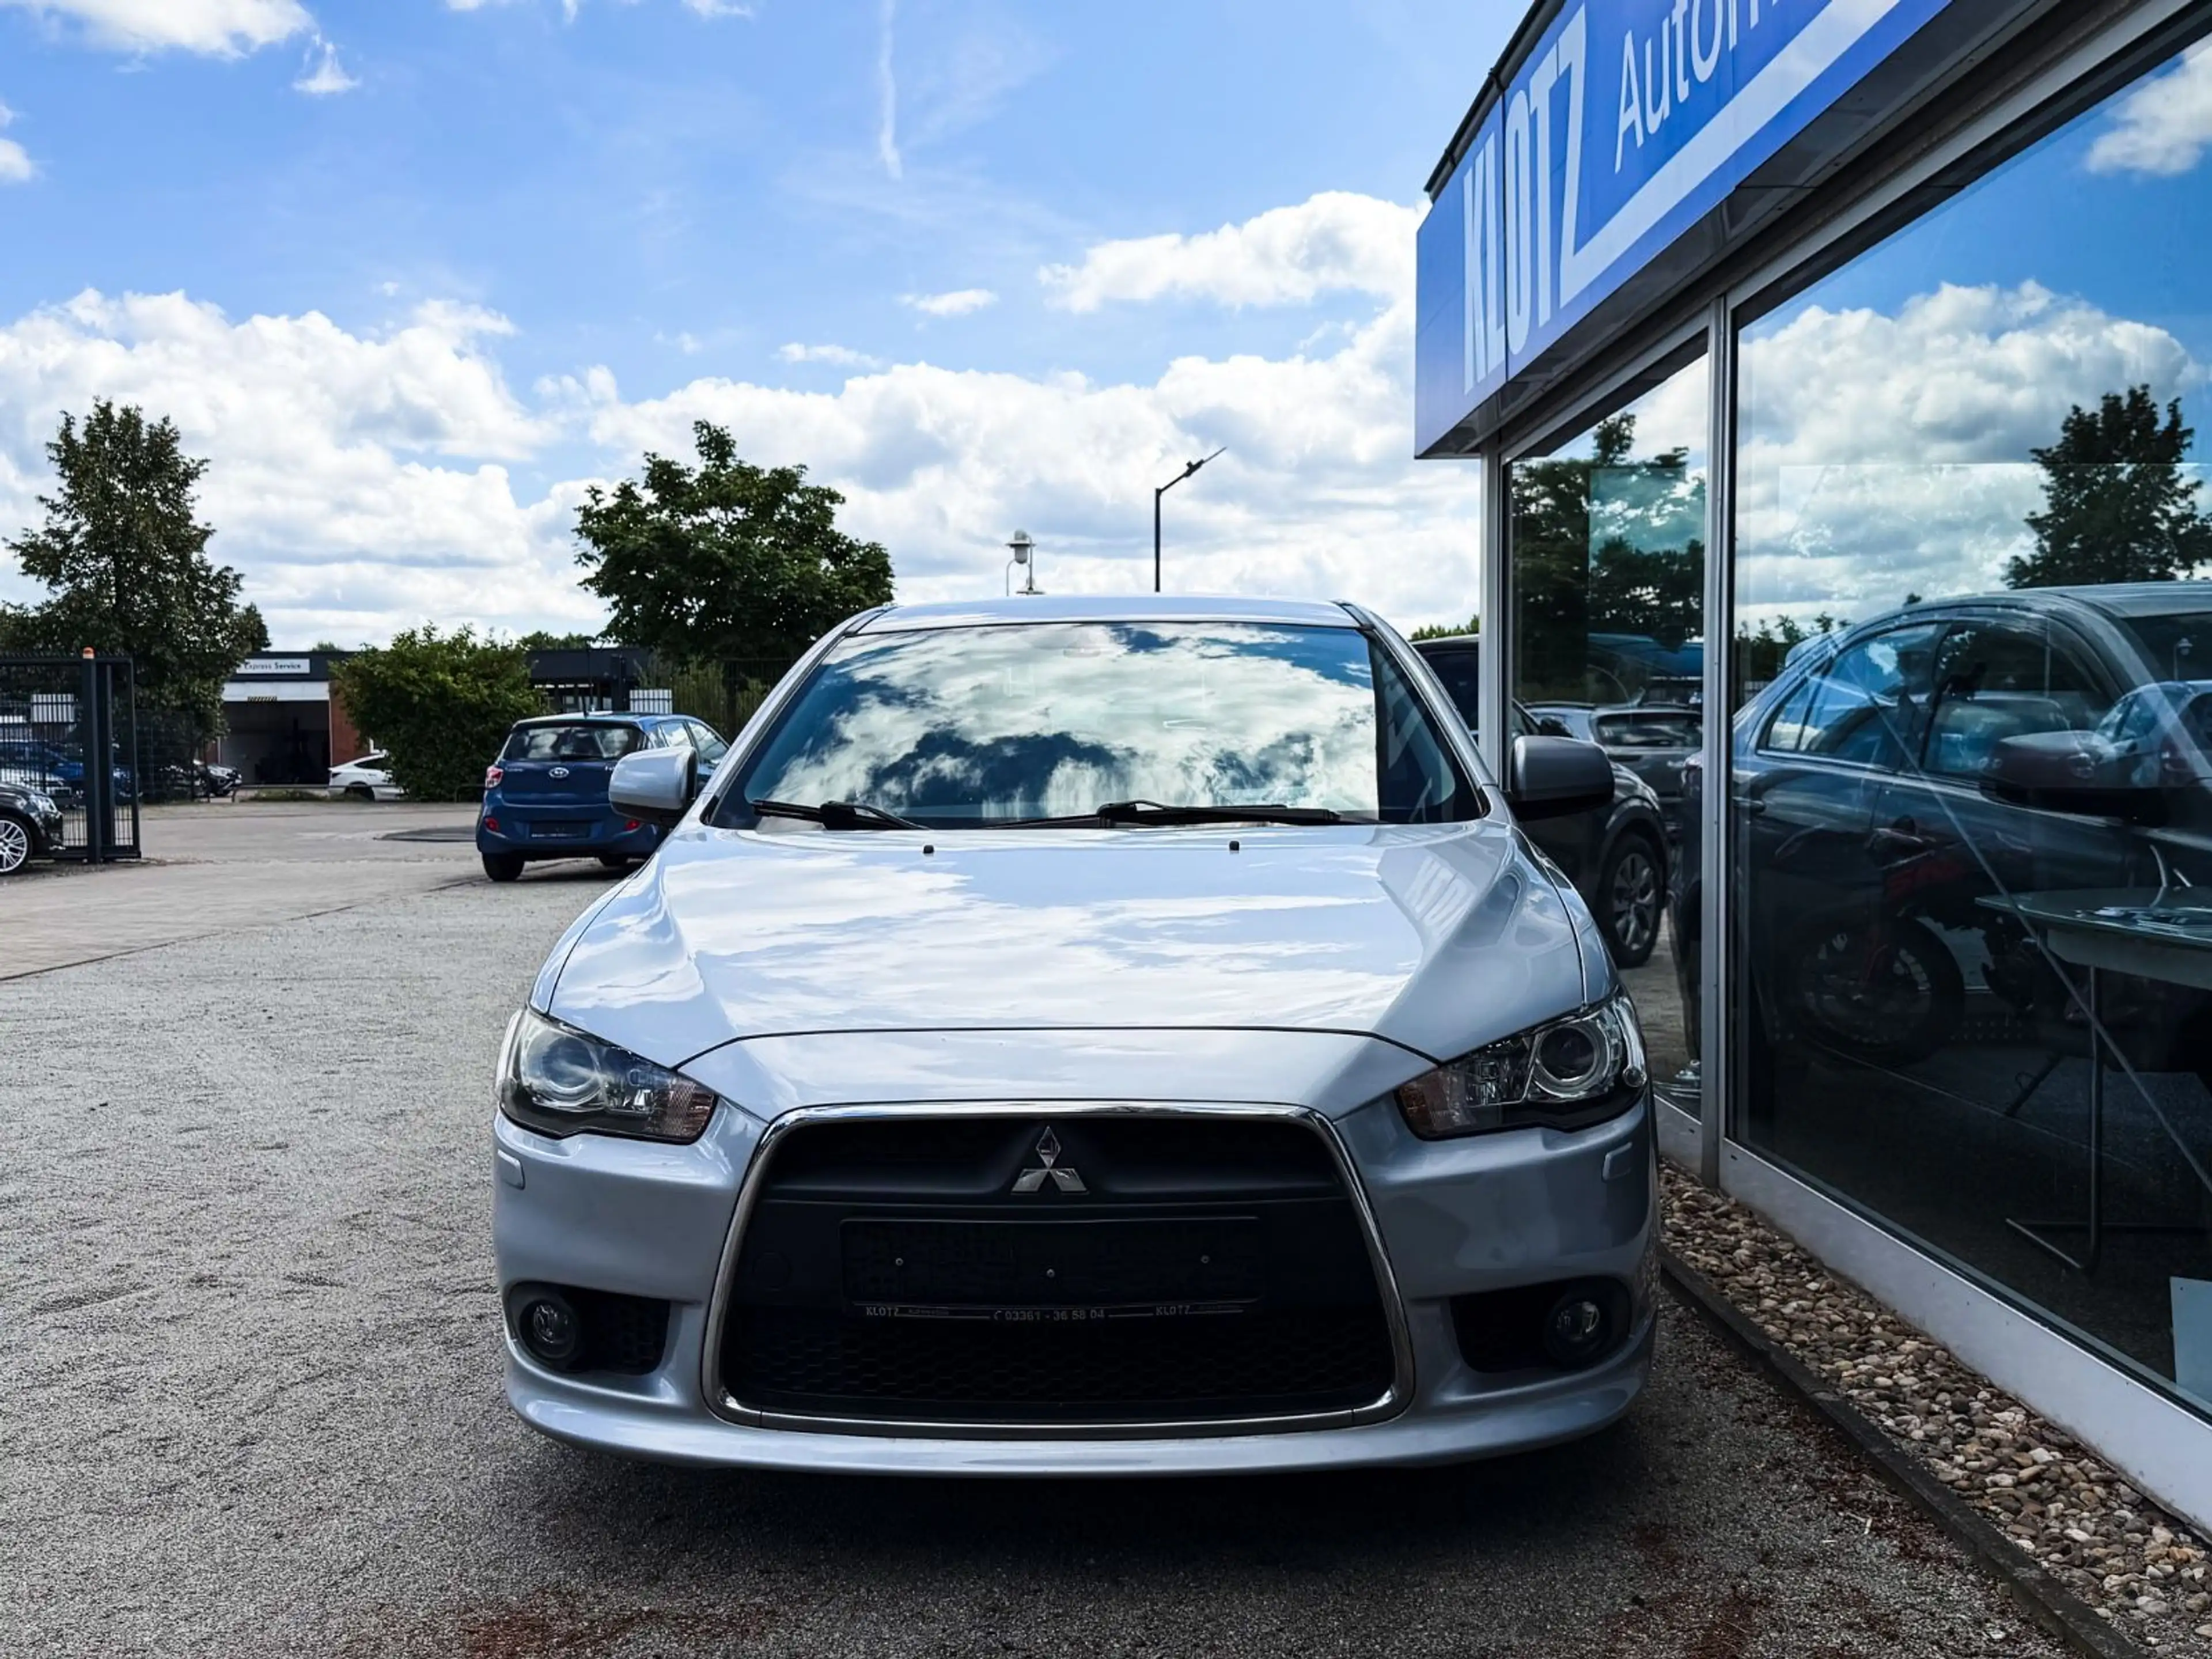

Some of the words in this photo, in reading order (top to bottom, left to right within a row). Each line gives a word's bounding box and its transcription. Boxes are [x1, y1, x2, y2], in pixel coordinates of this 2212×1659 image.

[1464, 2, 1585, 395] KLOTZ
[1615, 0, 1782, 174] Auto
[275, 661, 301, 669] Service
[865, 1306, 899, 1317] KLOTZ
[1155, 1305, 1191, 1316] KLOTZ
